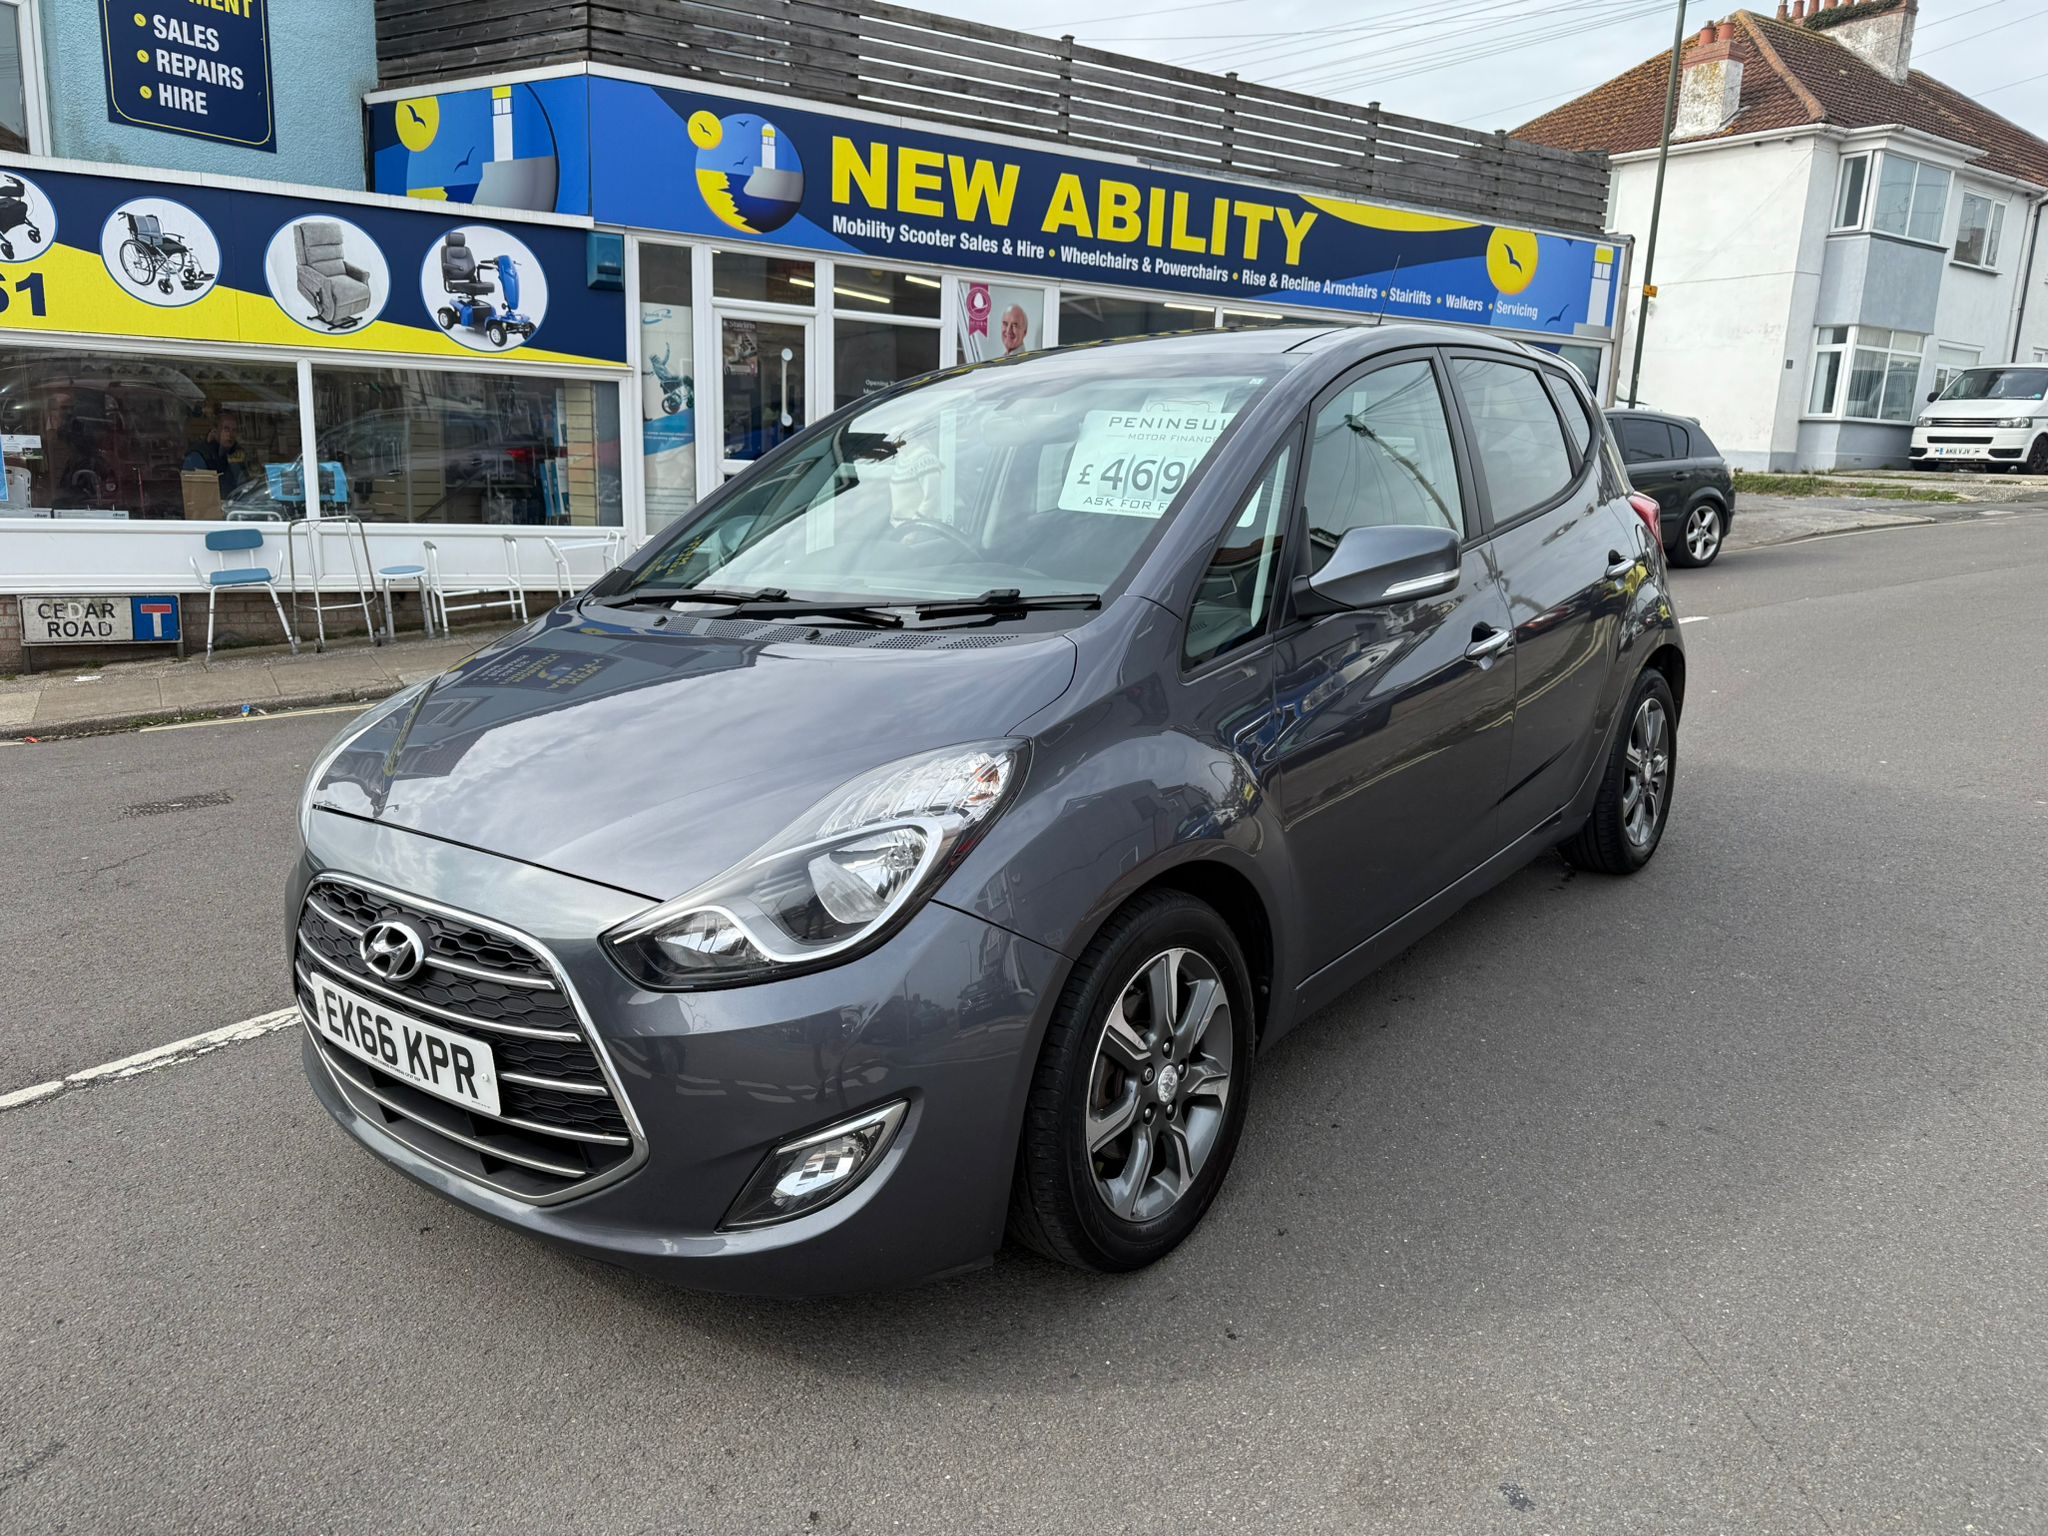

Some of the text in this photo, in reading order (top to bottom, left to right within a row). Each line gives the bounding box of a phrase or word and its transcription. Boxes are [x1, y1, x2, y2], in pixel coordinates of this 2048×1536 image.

[153, 14, 220, 52] SALES
[156, 48, 245, 91] REPAIRS
[158, 83, 208, 115] HIRE
[832, 135, 1319, 266] NEW ABILITY
[832, 214, 1539, 321] Mobility Scooter Sales & Hire Wheelchairs & Powerchairs Rise & Recline Armchairs Stairlifts Walkers Servicing
[1128, 432, 1166, 442] MOTOR
[1083, 496, 1113, 507] ASK
[1120, 499, 1152, 511] FOR
[38, 602, 115, 619] CEDAR
[47, 621, 112, 638] ROAD
[322, 986, 479, 1100] EK66 KPR
